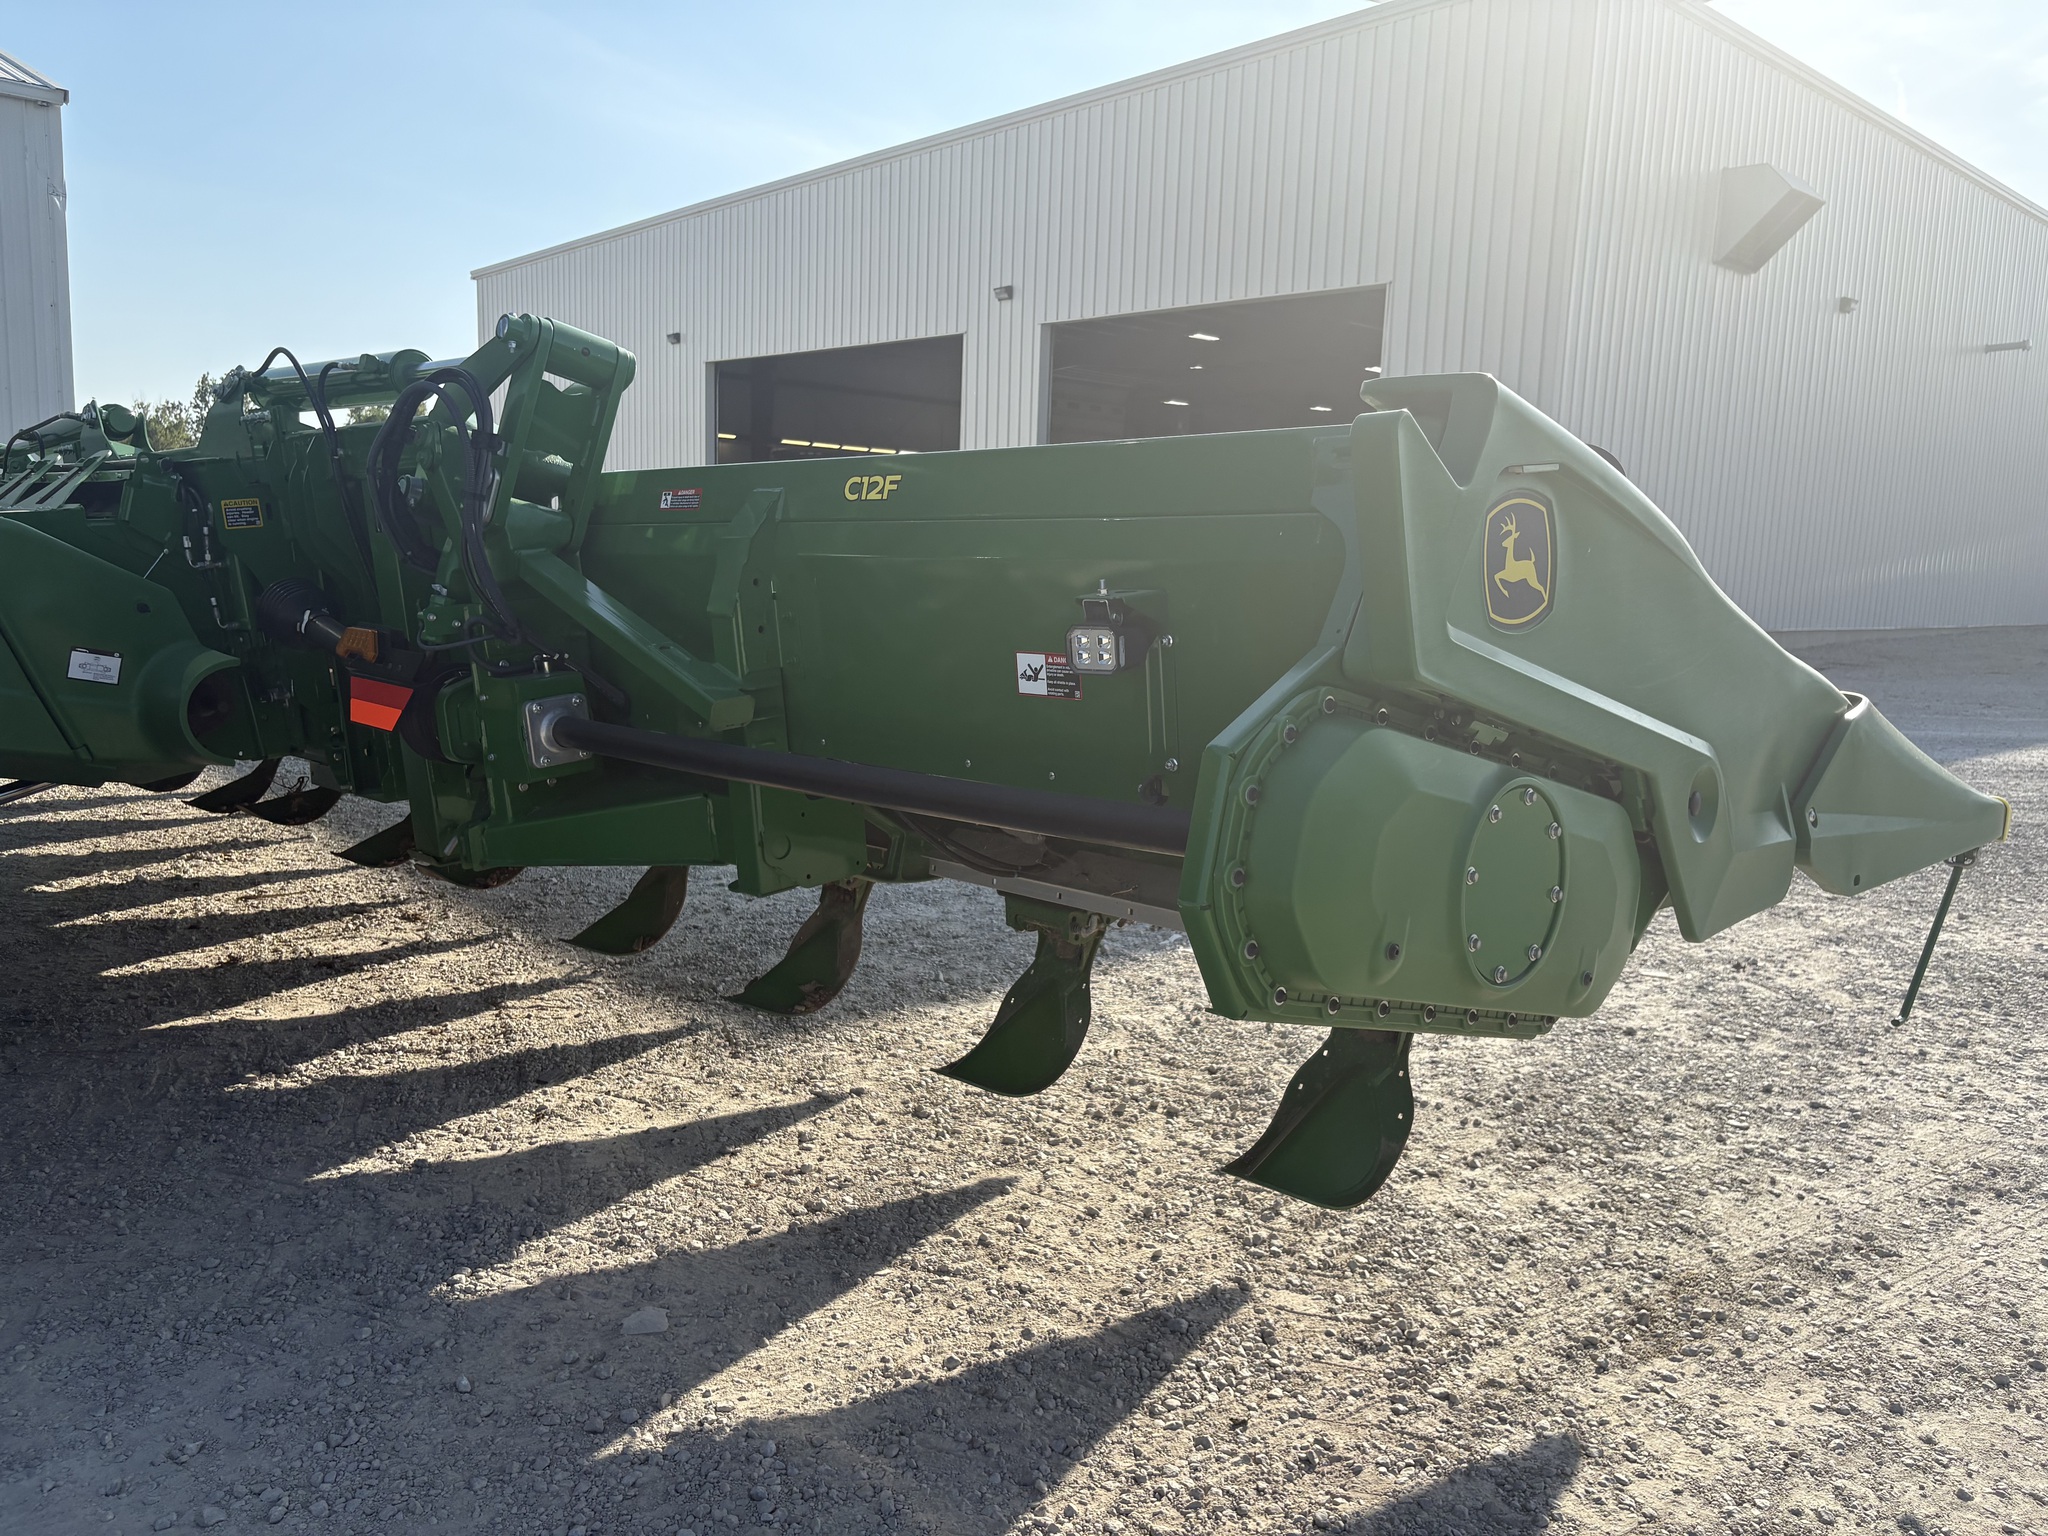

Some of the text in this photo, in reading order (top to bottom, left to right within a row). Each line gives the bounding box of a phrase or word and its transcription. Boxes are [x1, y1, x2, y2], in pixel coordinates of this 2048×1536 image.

[844, 474, 902, 501] C12F
[228, 499, 258, 507] CAUTION
[1053, 656, 1067, 664] DAN
